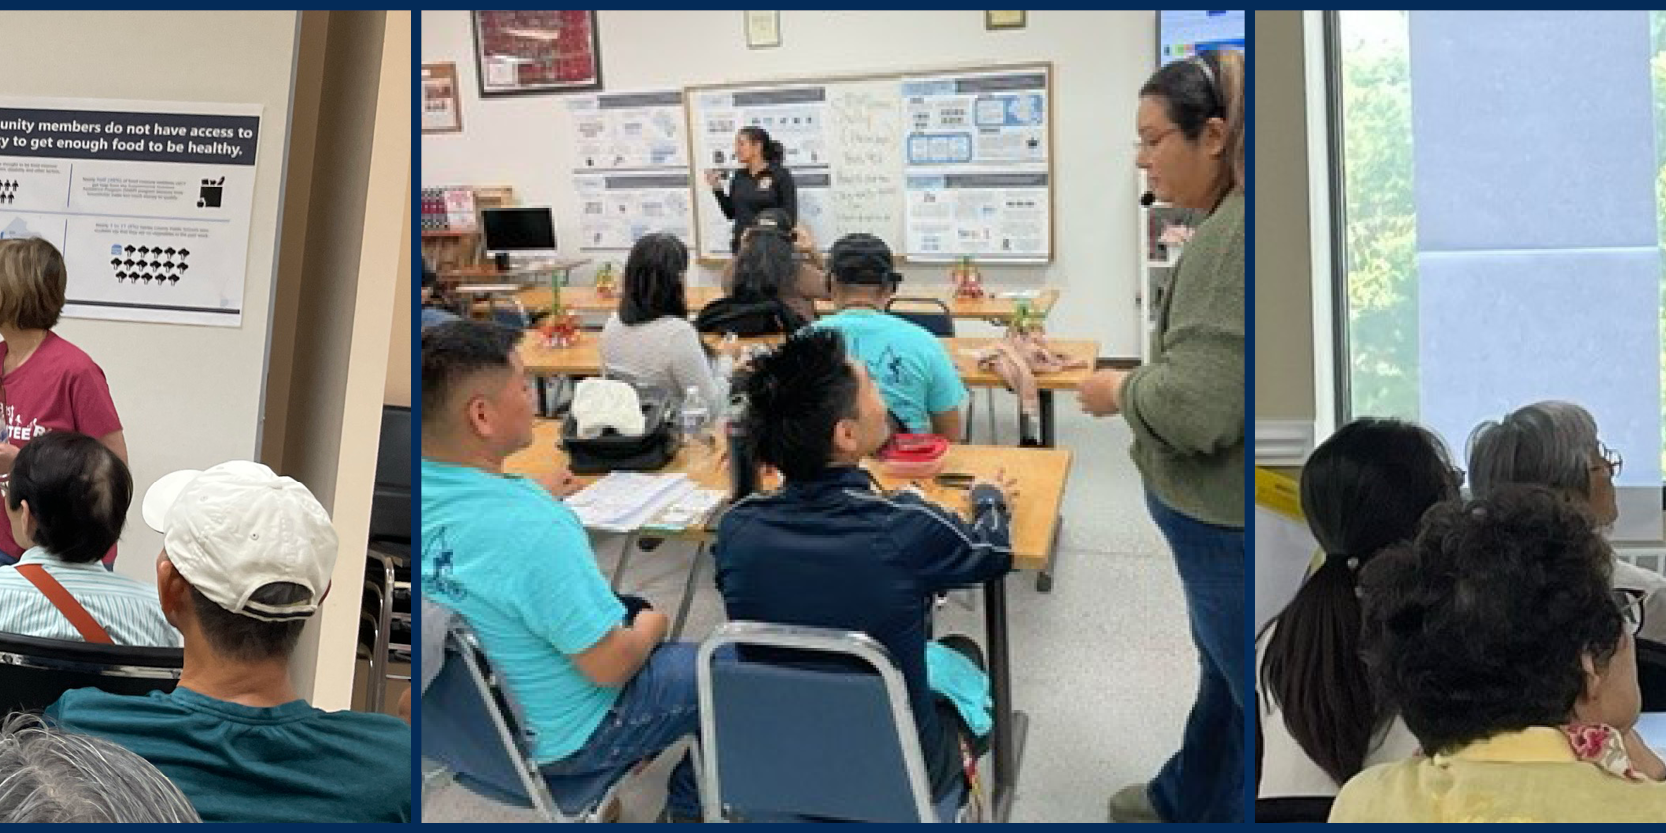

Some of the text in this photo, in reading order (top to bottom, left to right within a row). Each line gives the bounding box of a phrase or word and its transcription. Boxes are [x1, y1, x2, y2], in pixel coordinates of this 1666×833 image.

[38, 119, 101, 133] members
[105, 121, 123, 134] do
[126, 124, 150, 135] not
[154, 123, 186, 136] have
[190, 128, 234, 138] access
[238, 127, 253, 139] to
[13, 135, 27, 147] to
[30, 136, 53, 151] get
[56, 138, 108, 152] enough
[112, 138, 145, 151] food
[148, 140, 163, 152] to
[166, 140, 184, 153] be
[188, 141, 243, 158] healthy.
